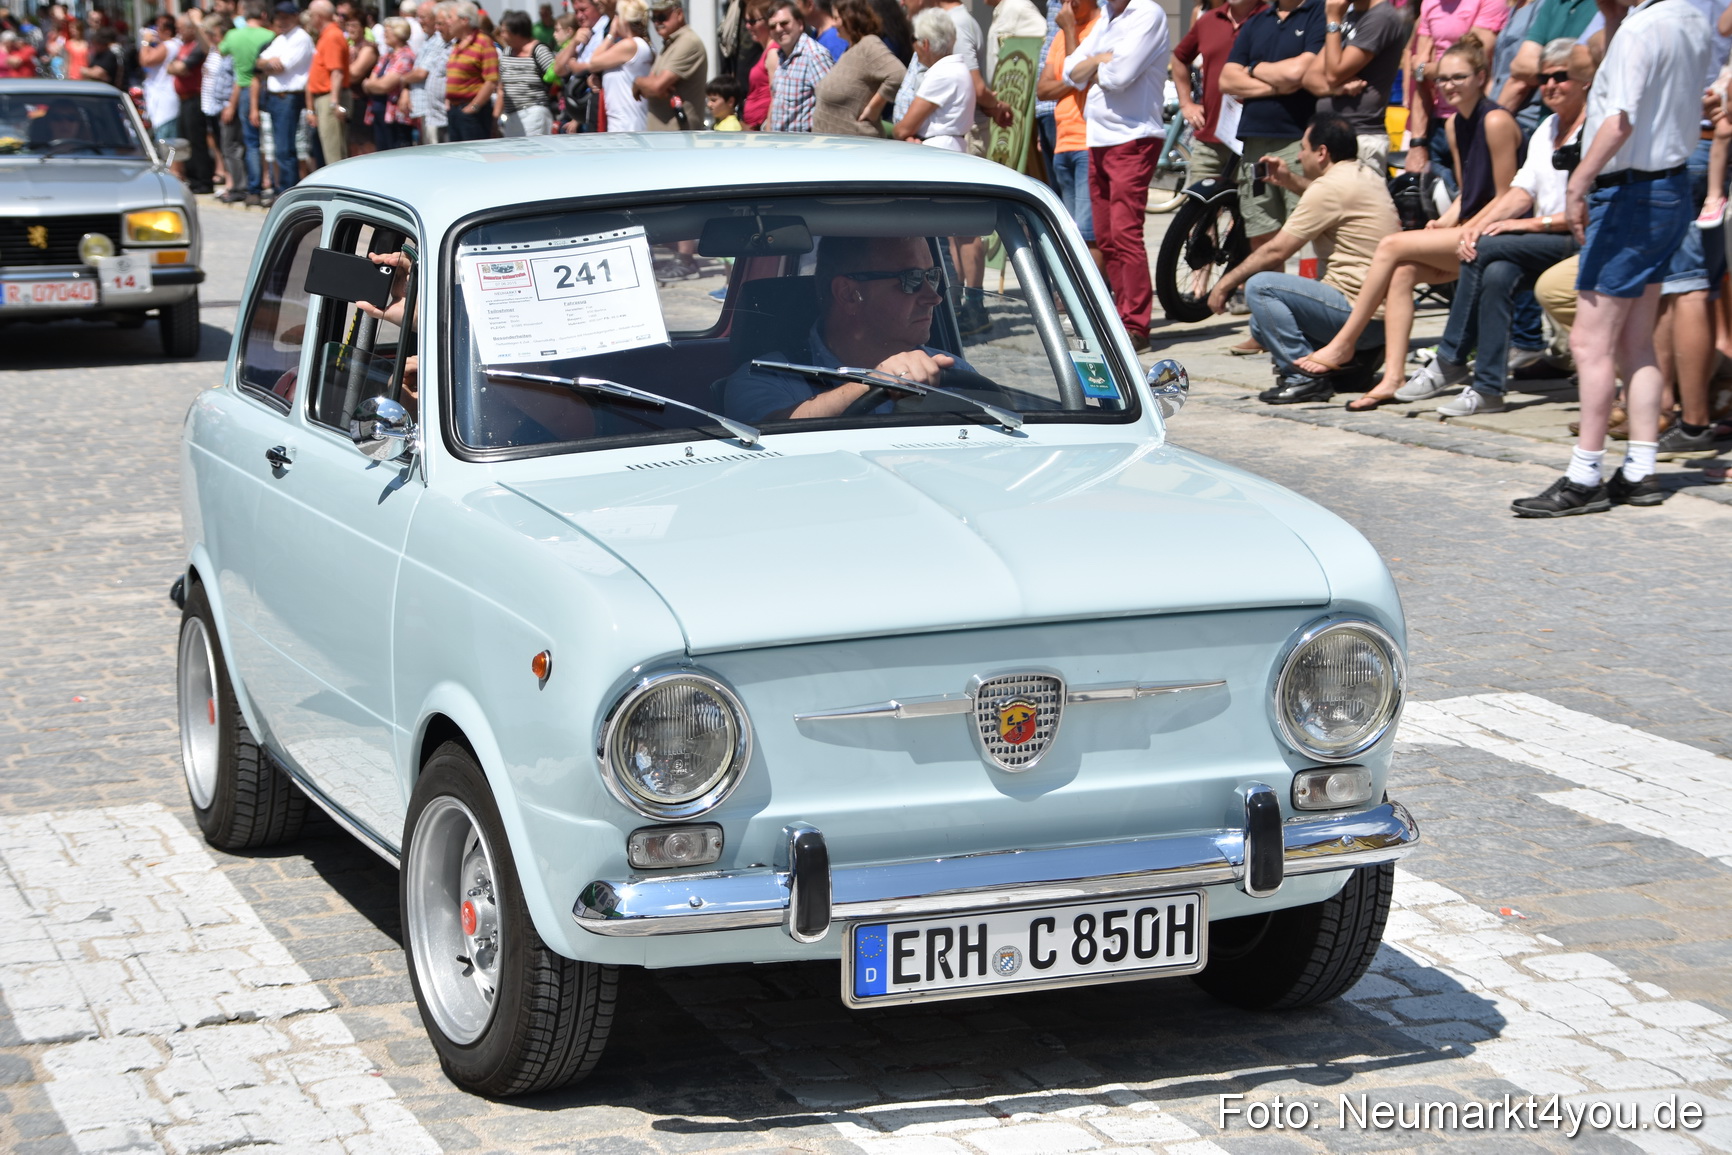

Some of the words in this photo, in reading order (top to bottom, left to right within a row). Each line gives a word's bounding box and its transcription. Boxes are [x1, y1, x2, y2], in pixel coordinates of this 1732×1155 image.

[113, 275, 136, 289] 14
[553, 258, 613, 290] 241
[7, 285, 20, 302] R
[32, 282, 93, 302] 07040
[492, 334, 532, 342] Besonderheiten
[892, 923, 988, 985] ERH
[1029, 916, 1057, 970] C
[1071, 903, 1195, 966] 850H
[865, 967, 877, 983] D
